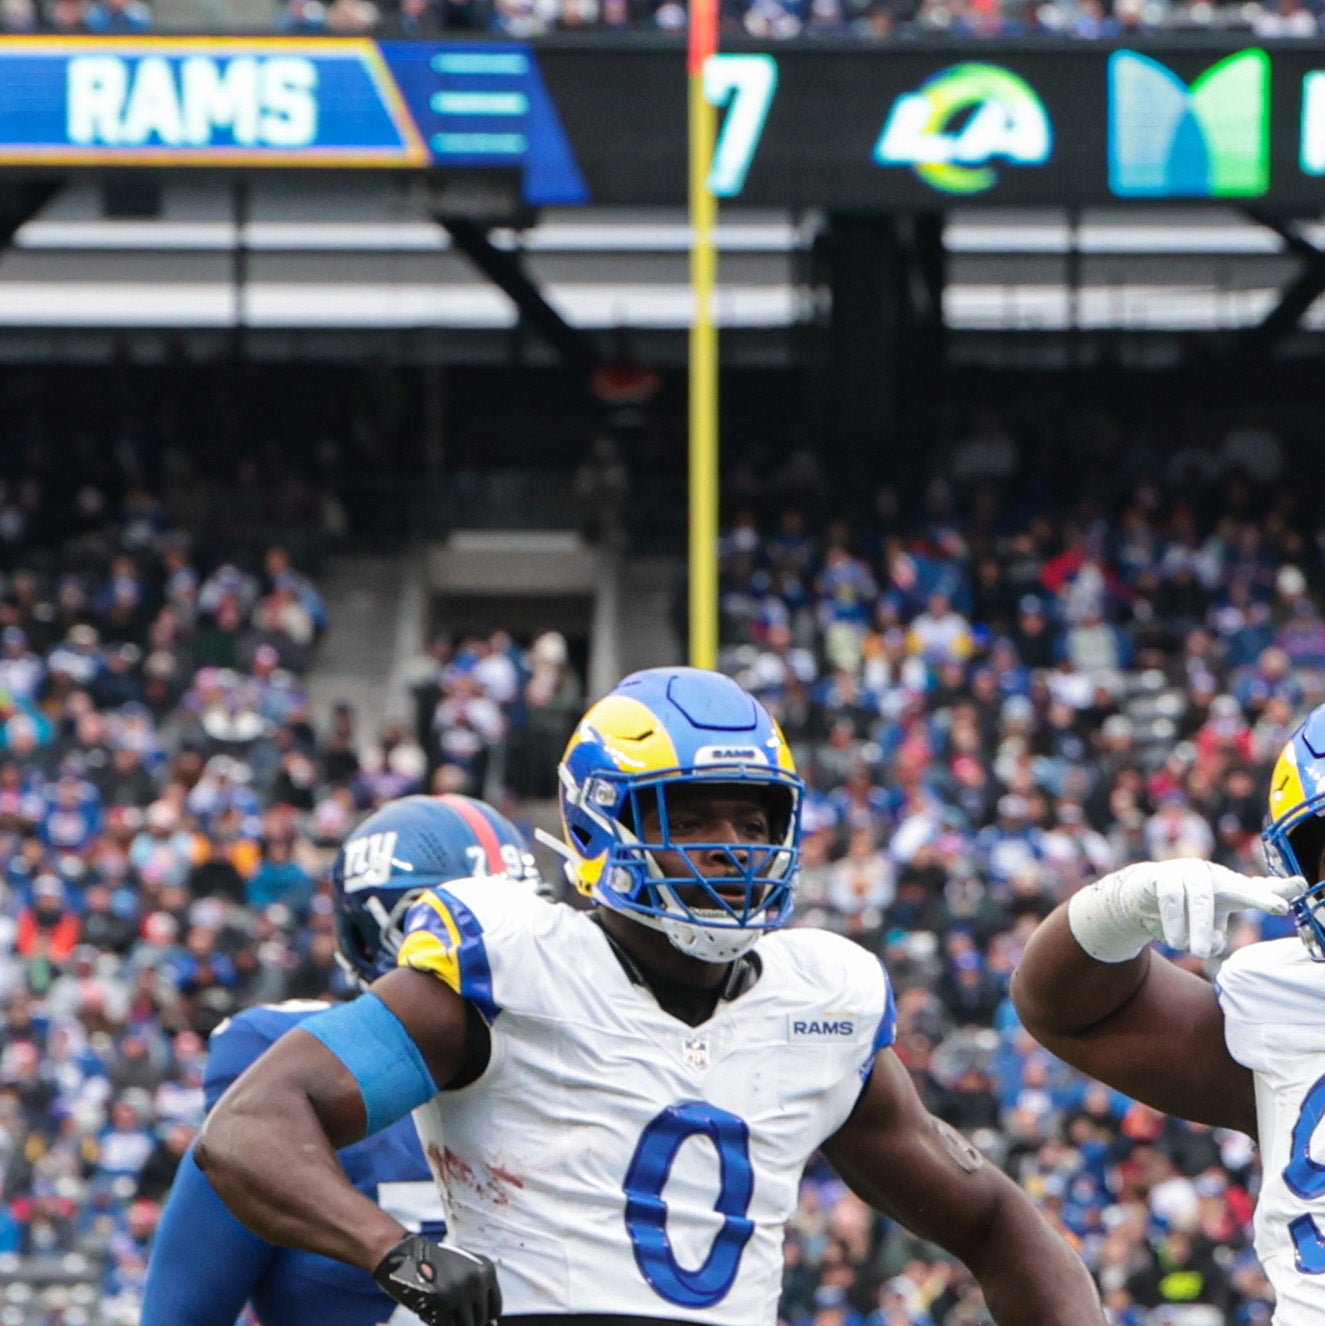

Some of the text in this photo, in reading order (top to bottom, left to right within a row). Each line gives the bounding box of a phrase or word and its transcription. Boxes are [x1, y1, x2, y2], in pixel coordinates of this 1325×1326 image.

[66, 56, 318, 148] RAMS
[702, 54, 778, 198] 7
[793, 1020, 853, 1035] RAMS
[624, 1100, 755, 1308] 0
